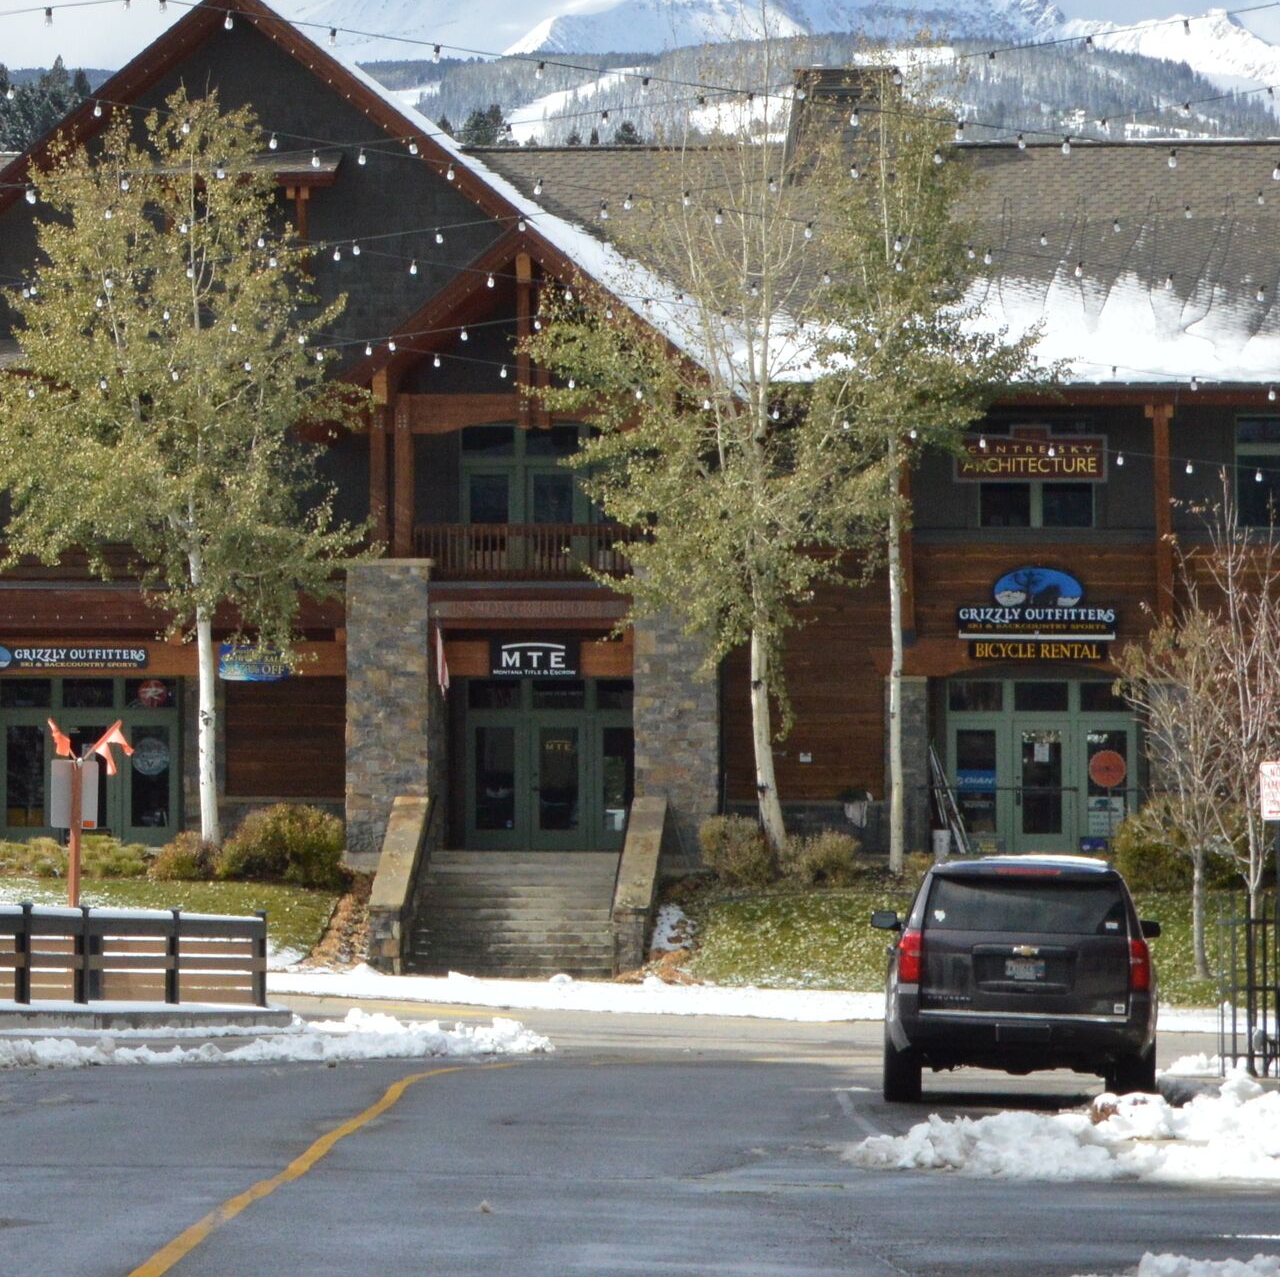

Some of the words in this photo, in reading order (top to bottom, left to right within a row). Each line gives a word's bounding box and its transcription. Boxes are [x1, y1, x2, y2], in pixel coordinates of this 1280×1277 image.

[968, 445, 1046, 453] CENTRE
[1058, 445, 1093, 453] SKY
[963, 457, 1097, 473] ARCHITECTURE
[959, 608, 1021, 623] GRIZZLY
[1025, 608, 1115, 623] OUTFITTERS
[14, 649, 67, 662] GRIZZLY
[69, 649, 146, 662] OUTFITTERS
[976, 642, 1036, 658] BICYCLE
[1040, 643, 1101, 659] RENTAL
[501, 651, 566, 668] MTE
[261, 664, 285, 675] OFF
[545, 743, 573, 751] MTE
